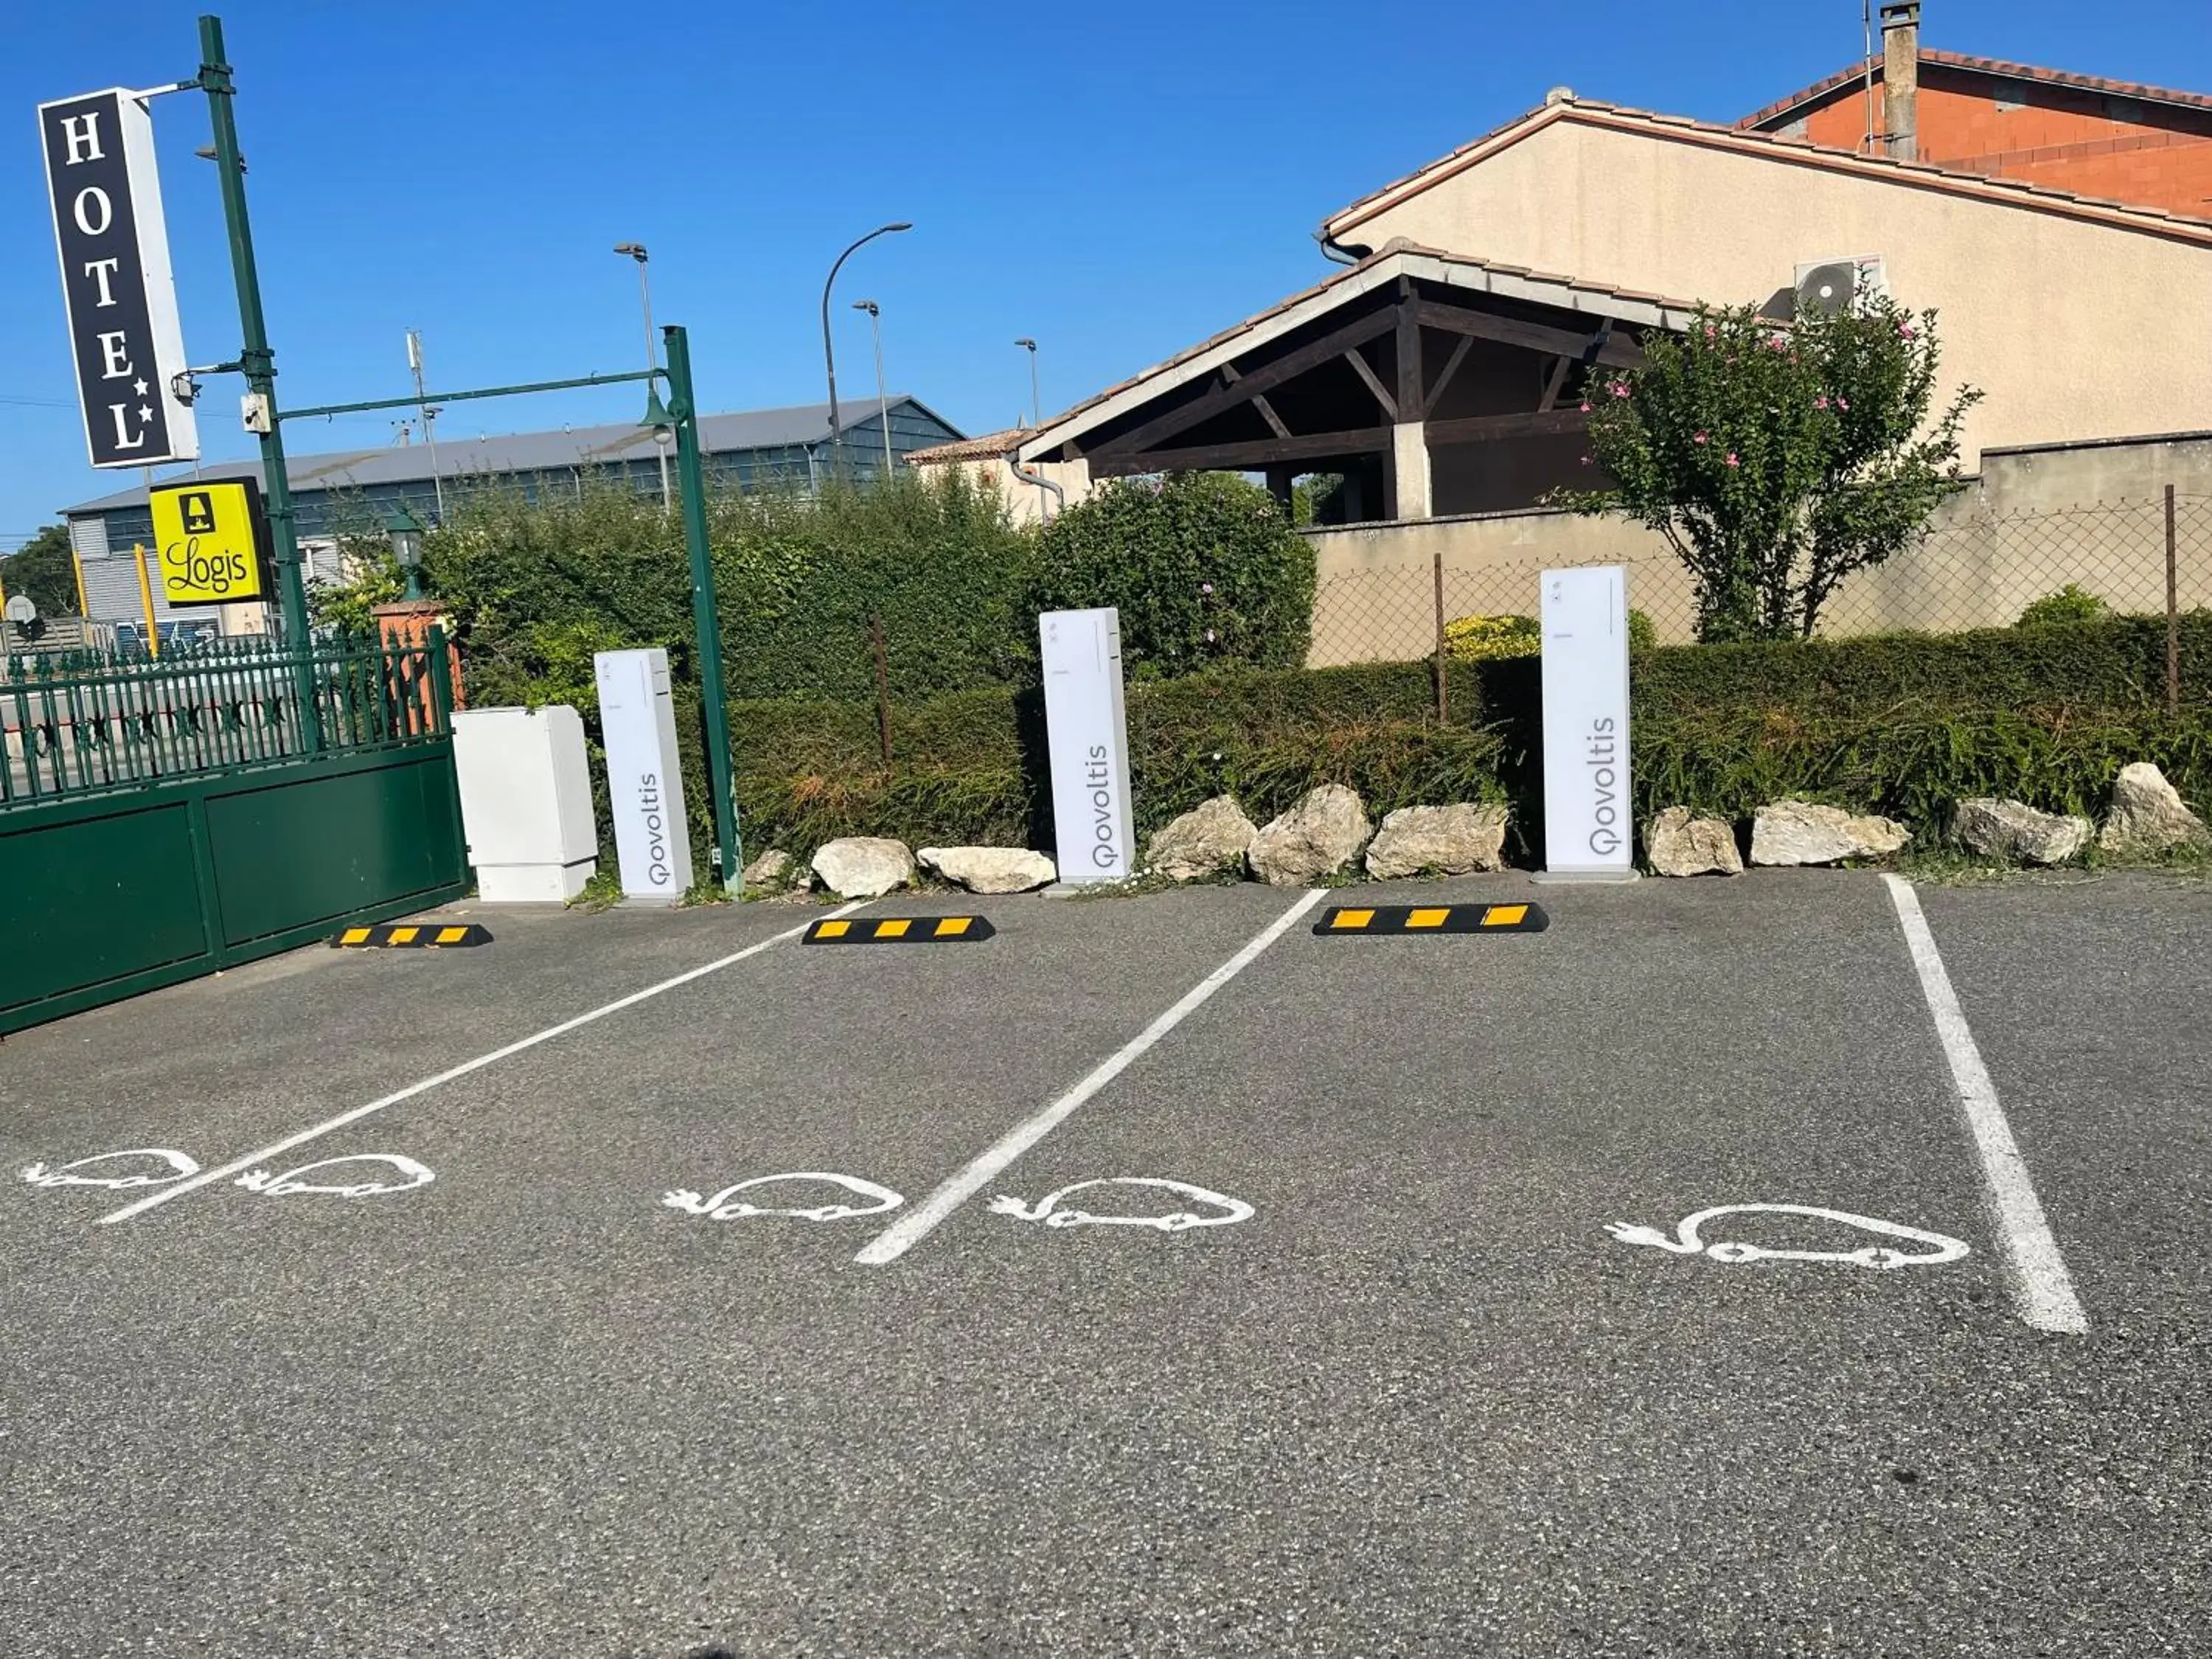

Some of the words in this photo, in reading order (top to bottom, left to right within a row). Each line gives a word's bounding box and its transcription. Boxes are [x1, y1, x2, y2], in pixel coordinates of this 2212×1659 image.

[60, 111, 145, 450] HOTEL
[166, 537, 247, 594] Logis
[638, 772, 670, 886] Qovoltis
[1085, 744, 1119, 869] Qovoltis
[1586, 716, 1621, 855] Qovoltis
